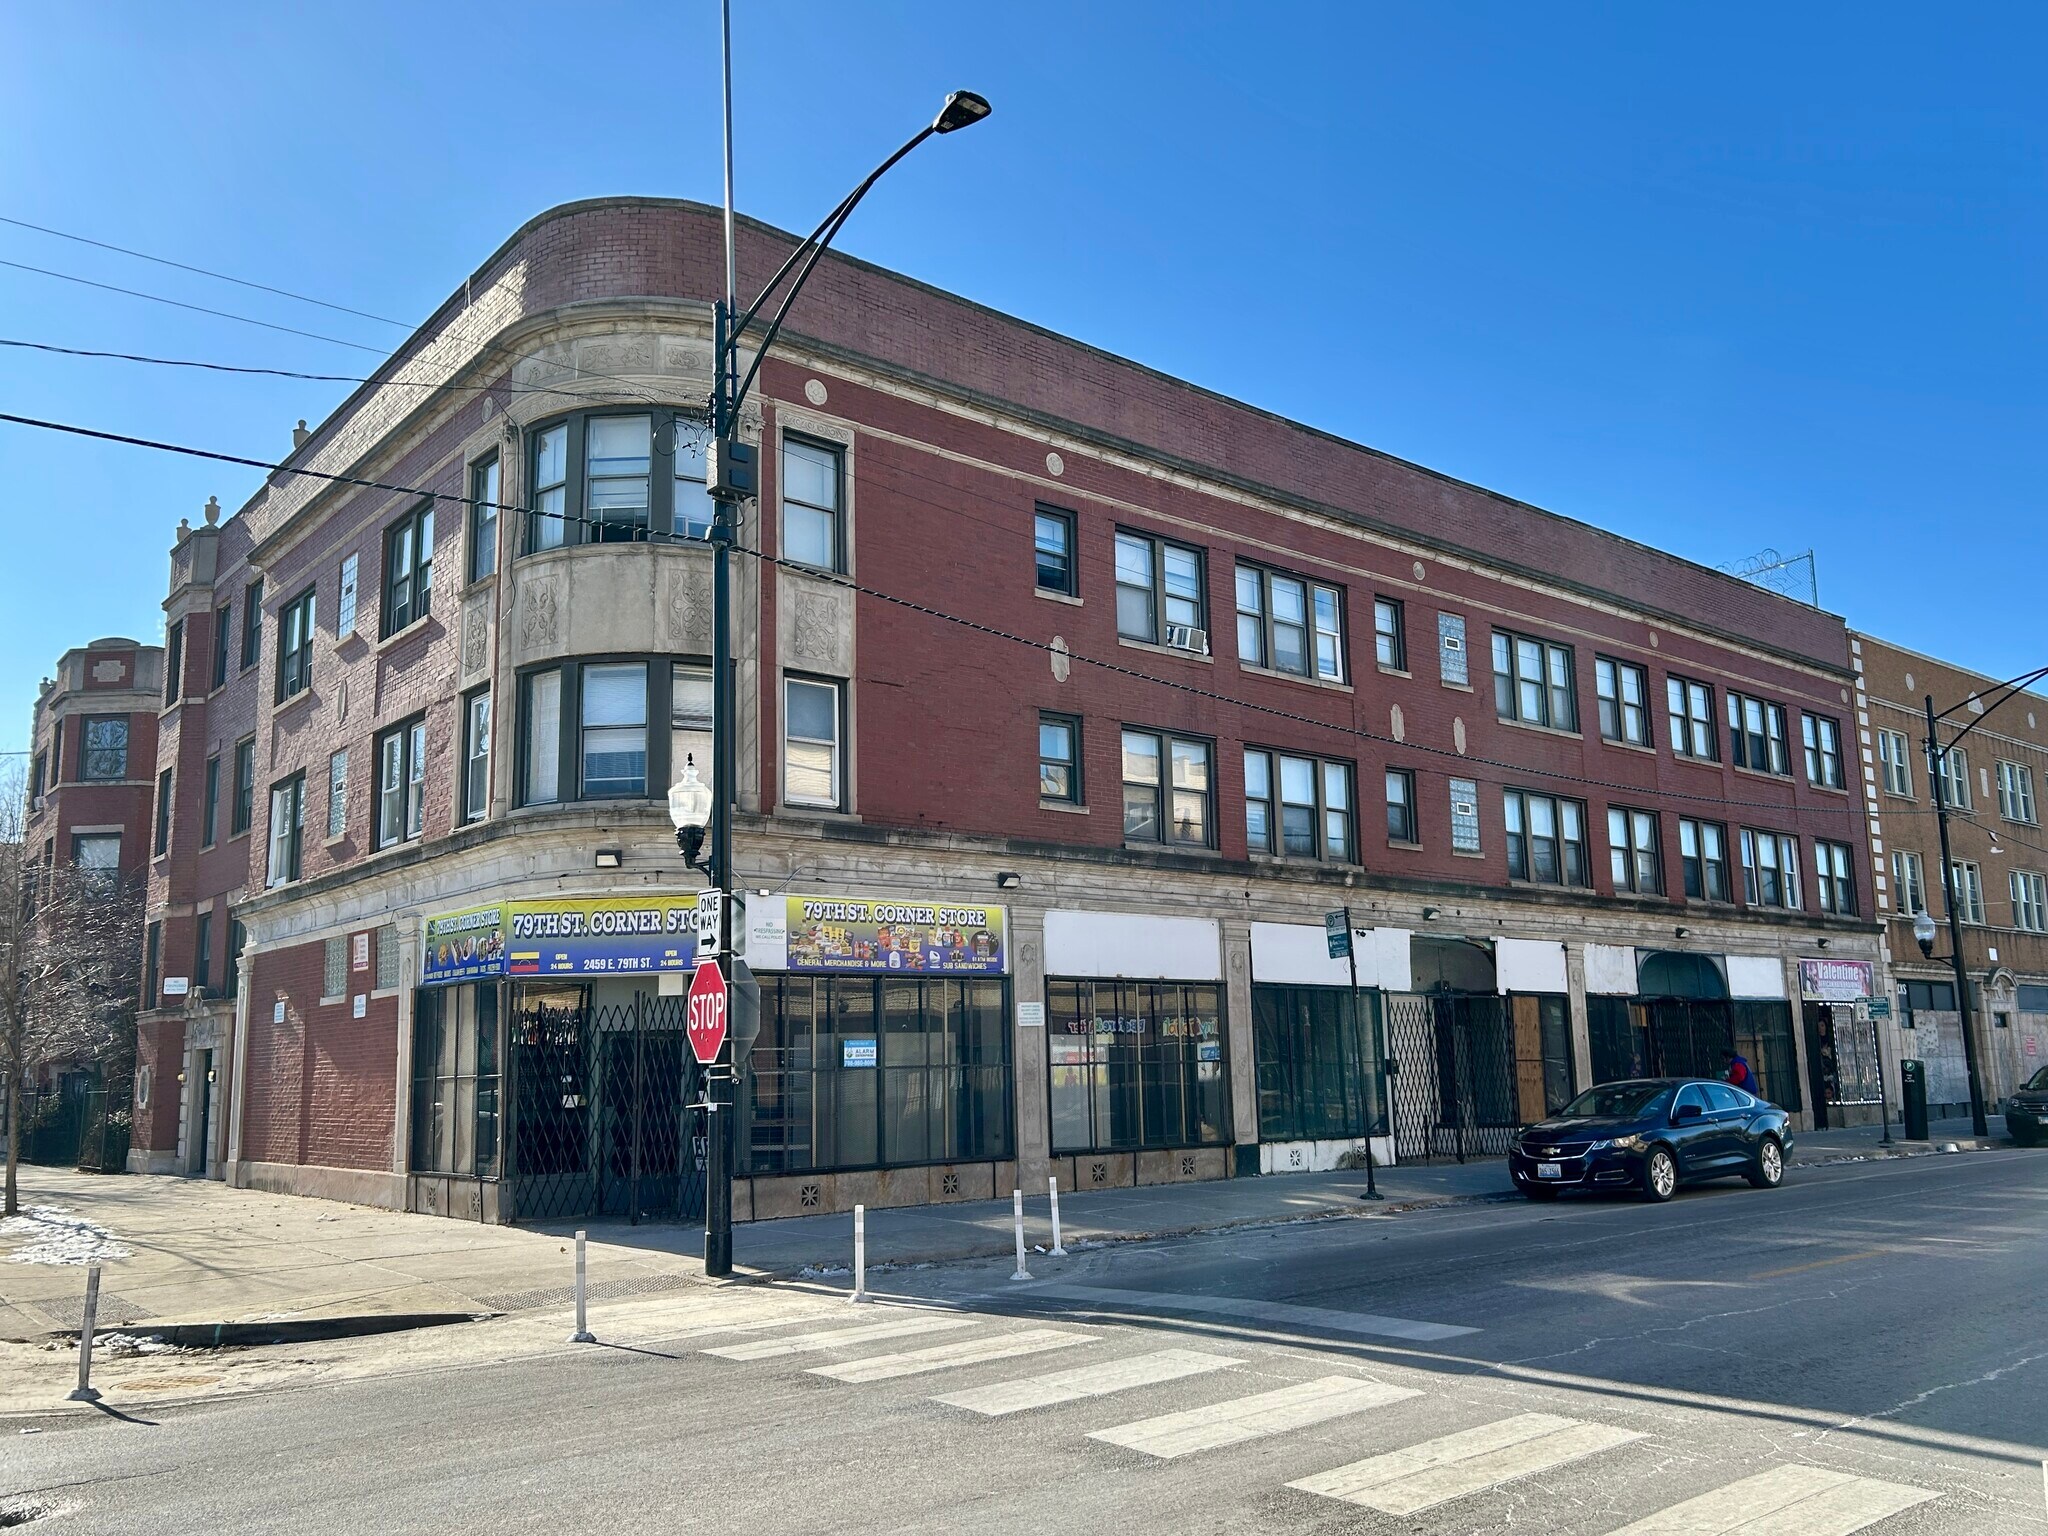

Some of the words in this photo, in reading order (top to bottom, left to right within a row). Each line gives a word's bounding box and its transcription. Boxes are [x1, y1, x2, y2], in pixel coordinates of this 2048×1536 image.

[700, 895, 718, 913] ONE
[459, 913, 481, 930] CORNER
[481, 909, 500, 926] STORE
[699, 914, 719, 931] WAY
[804, 901, 846, 921] 79TH
[848, 904, 872, 922] ST.
[873, 904, 935, 925] CORNER
[938, 907, 986, 927] STORE
[513, 911, 559, 939] 79TH
[560, 912, 588, 936] ST.
[590, 909, 662, 935] CORNER
[666, 908, 698, 932] STO
[755, 927, 784, 935] TRESPASSING
[558, 962, 574, 971] HOURS
[583, 958, 606, 970] 2459
[607, 957, 616, 970] E.
[617, 957, 638, 970] 79TH
[639, 957, 653, 969] ST.
[668, 959, 684, 967] HOURS
[797, 958, 823, 968] GENERAL
[824, 959, 863, 968] MERCHANDISE
[870, 960, 887, 968] MORE
[954, 962, 987, 970] SANDWICHES
[1817, 962, 1859, 981] Valentine
[690, 991, 725, 1031] STOP
